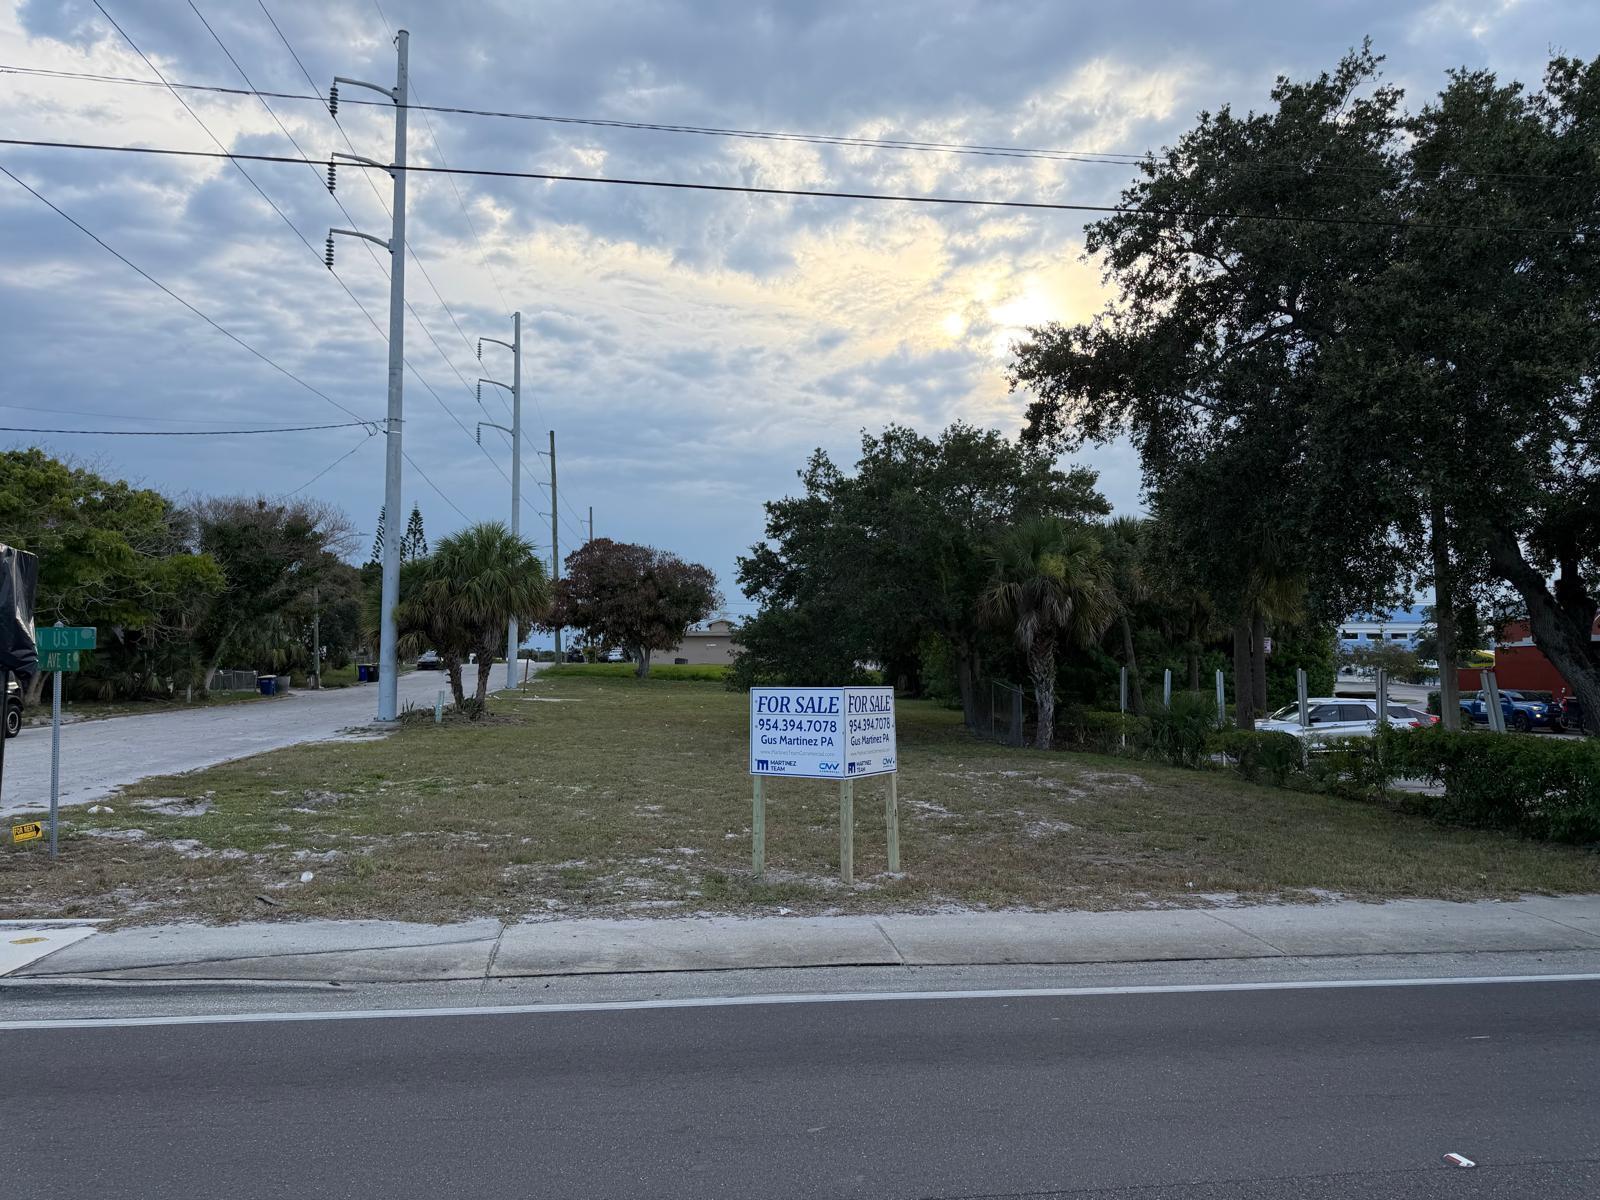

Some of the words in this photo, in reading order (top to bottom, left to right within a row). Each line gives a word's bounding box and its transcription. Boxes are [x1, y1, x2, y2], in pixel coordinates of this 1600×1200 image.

[53, 631, 68, 648] US
[47, 652, 61, 668] AVE
[67, 653, 71, 668] E
[757, 696, 790, 713] FOR
[795, 696, 840, 714] SALE
[848, 694, 868, 713] FOR
[869, 695, 891, 712] SALE
[758, 718, 837, 733] 954.394.7078
[849, 717, 891, 733] 954.394.7078
[760, 735, 777, 745] Gus
[779, 735, 818, 746] Martinez
[820, 736, 834, 747] PA
[850, 737, 861, 747] Gus
[861, 735, 883, 746] Martinez
[882, 733, 890, 743] PA
